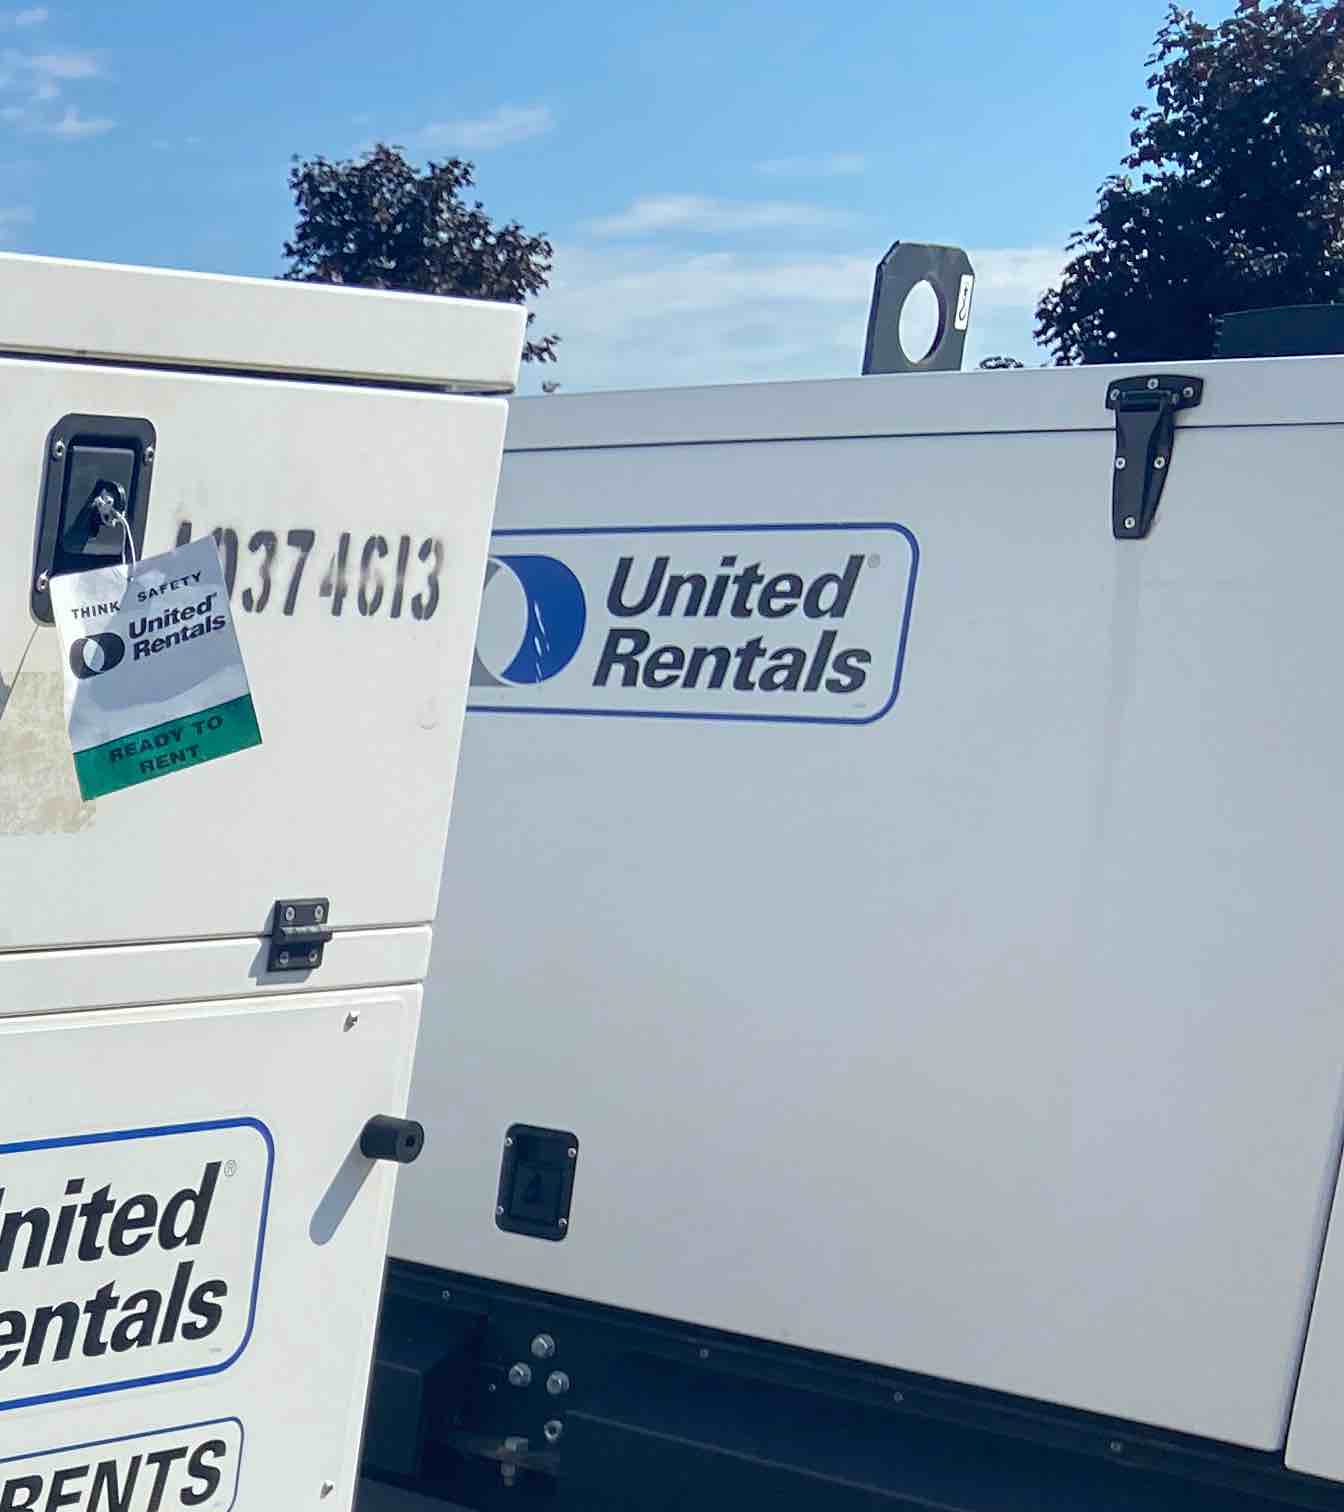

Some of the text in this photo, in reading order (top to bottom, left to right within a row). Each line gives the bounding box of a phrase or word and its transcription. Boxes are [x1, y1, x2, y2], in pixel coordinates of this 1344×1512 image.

[71, 571, 201, 619] THINK SAFETY
[175, 522, 445, 620] 0374613
[605, 554, 865, 619] United
[129, 595, 214, 639] United
[133, 614, 226, 661] Rentals
[592, 628, 872, 694] Rentals
[108, 715, 224, 764] READY TO
[139, 744, 200, 774] RENT
